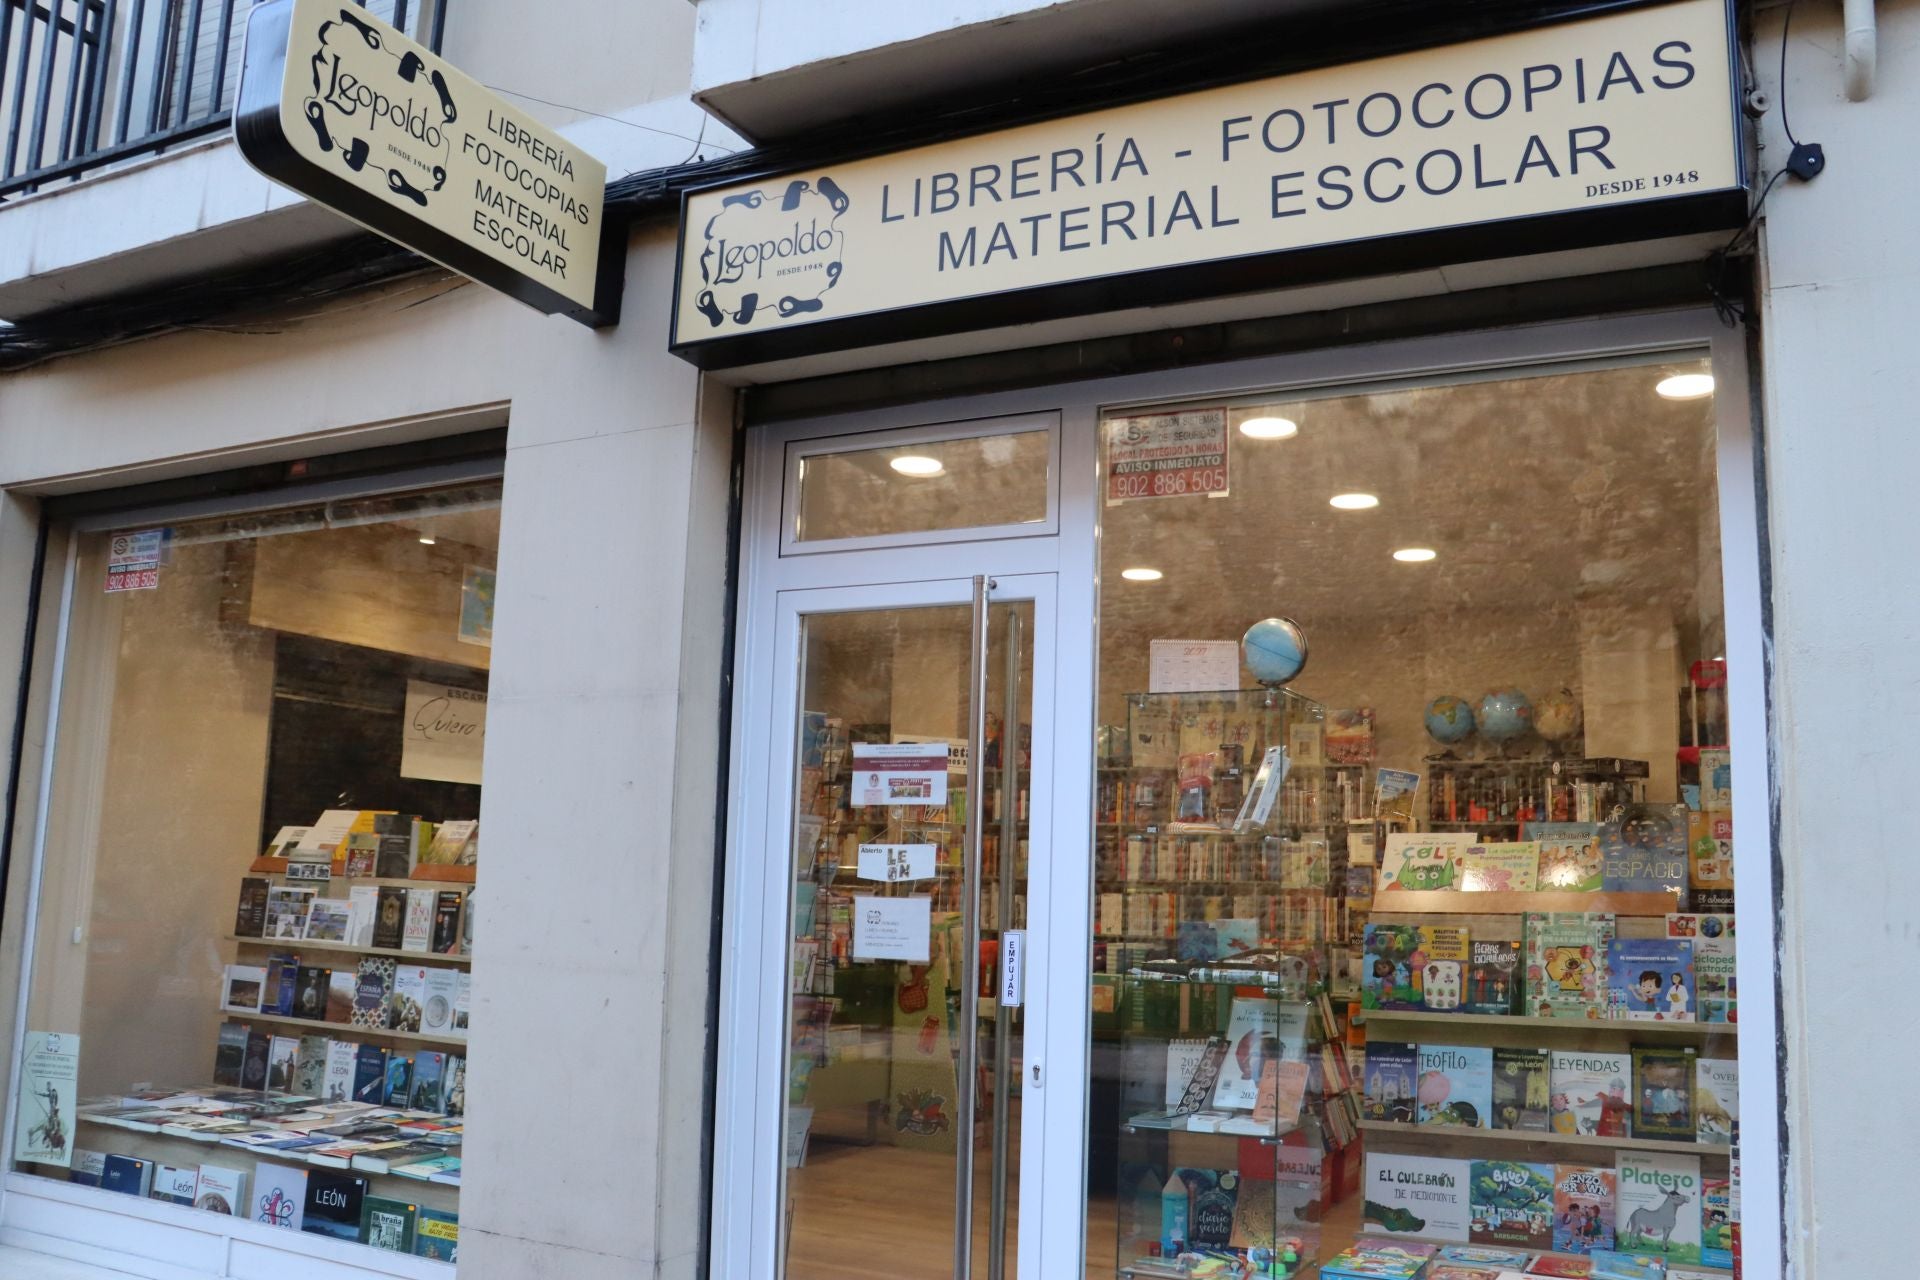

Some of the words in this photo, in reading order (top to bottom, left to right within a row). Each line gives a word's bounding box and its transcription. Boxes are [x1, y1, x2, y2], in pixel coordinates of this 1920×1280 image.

[324, 54, 442, 149] Leopoldo
[881, 132, 1150, 224] LIBRERÍA
[1221, 39, 1696, 162] FOTOCOPIAS
[487, 109, 575, 183] LIBRERÍA
[387, 142, 412, 161] DESDE
[412, 157, 432, 174] 1948
[462, 133, 590, 226] FOTOCOPIAS
[1585, 177, 1647, 198] DESDE
[1652, 169, 1701, 189] 1948
[938, 184, 1240, 273] MATERIAL
[1270, 125, 1617, 219] ESCOLAR
[474, 179, 571, 252] MATERIAL
[472, 210, 567, 280] ESCOLAR
[713, 217, 833, 286] Leopoldo
[776, 266, 802, 277] DESDE
[803, 263, 824, 272] 1948
[1139, 446, 1183, 459] PROTEGIDO
[1116, 460, 1151, 474] AVISO
[1154, 455, 1221, 470] INMEDIATO
[1117, 475, 1149, 497] 902
[1154, 472, 1186, 495] 886
[1191, 469, 1224, 491] 505
[141, 571, 157, 586] 505
[413, 696, 478, 740] Quiero
[1605, 861, 1683, 879] ESPACIO
[1007, 940, 1016, 998] EMPUJAR
[1418, 1050, 1467, 1073] TEÓFILO
[1551, 1058, 1621, 1074] LEYENDAS
[172, 1178, 194, 1194] León
[1379, 1169, 1394, 1182] EL
[1397, 1170, 1455, 1188] CULEBRÓN
[1568, 1173, 1601, 1185] ENZO
[1621, 1166, 1694, 1188] Platero
[315, 1187, 347, 1209] LEÓN
[1394, 1188, 1406, 1198] DE
[381, 1213, 402, 1225] braña
